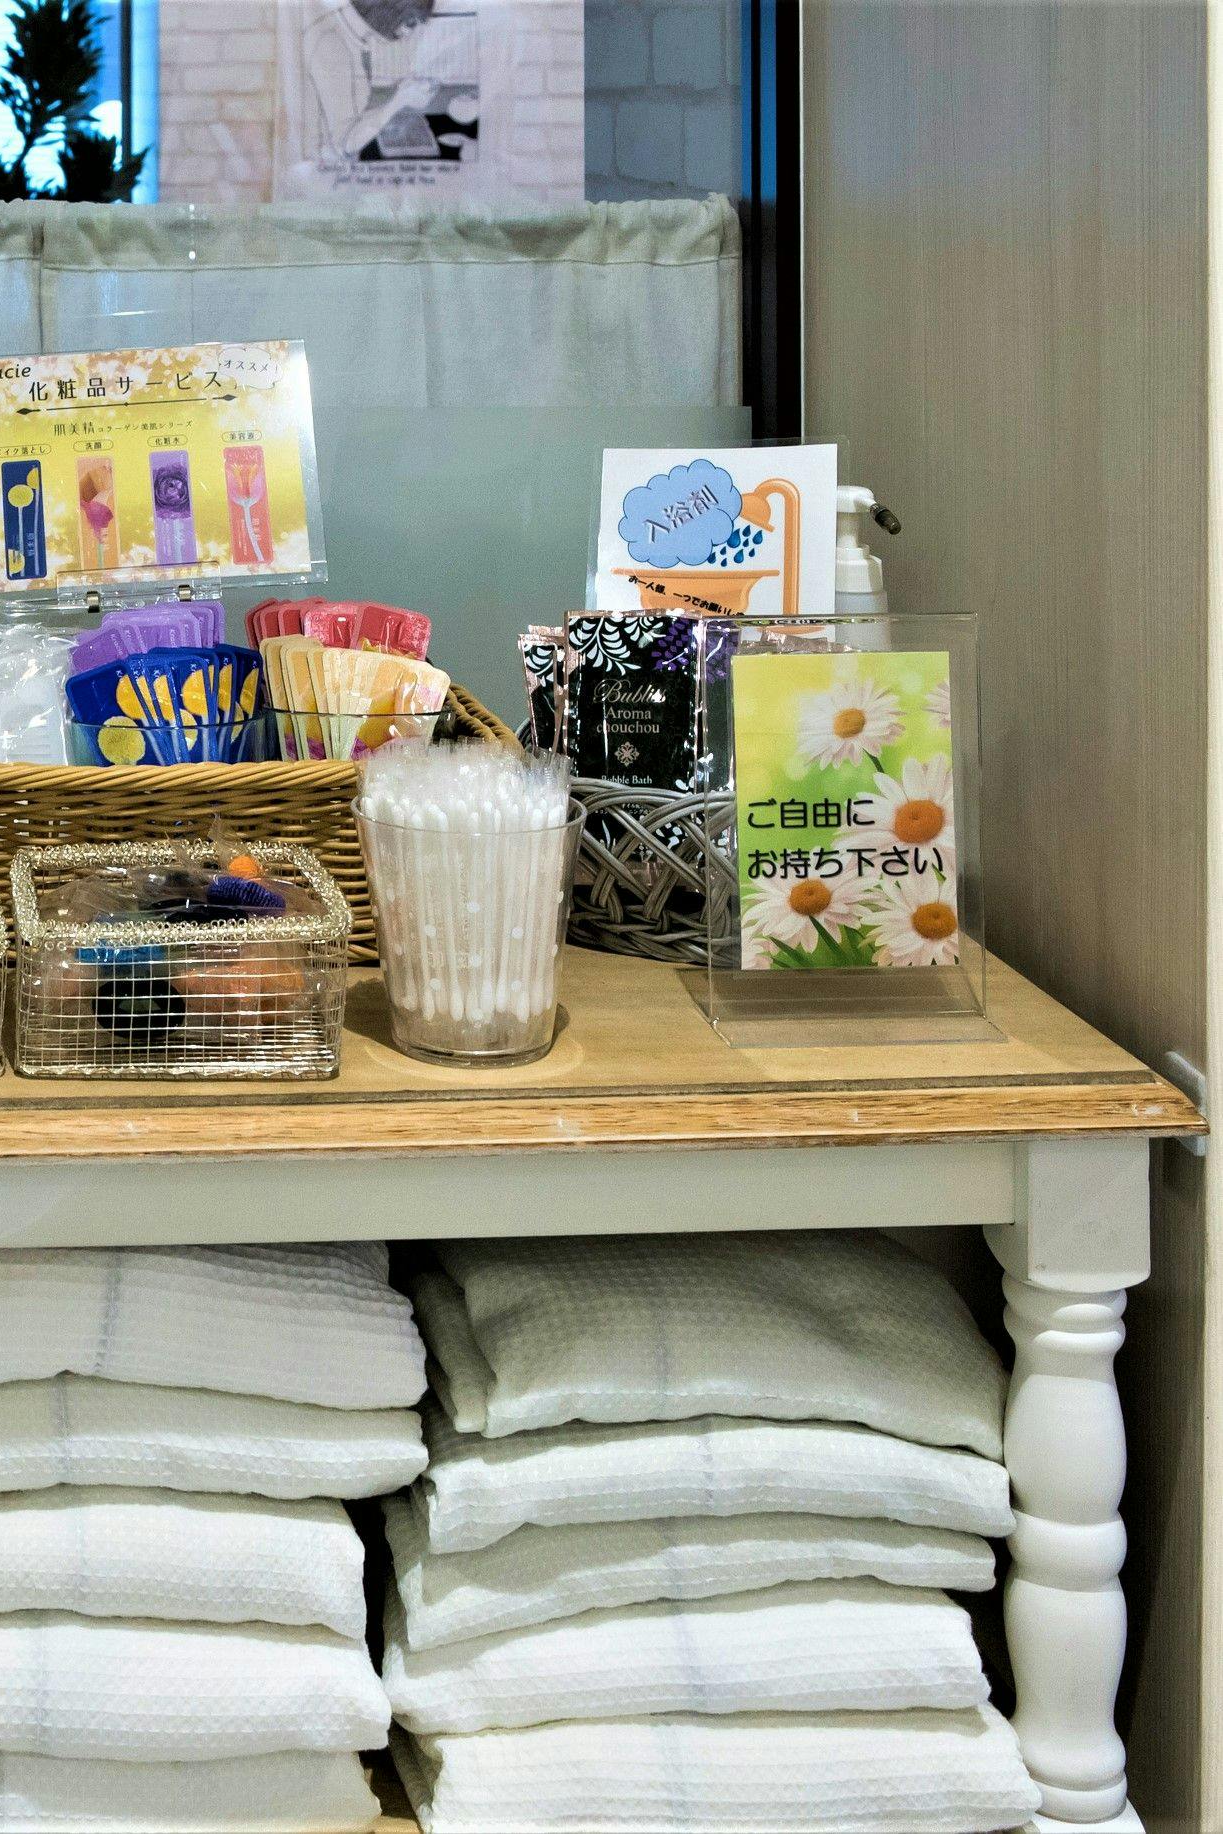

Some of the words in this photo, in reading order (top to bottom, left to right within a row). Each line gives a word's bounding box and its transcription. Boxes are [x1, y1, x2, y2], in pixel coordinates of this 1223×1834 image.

[29, 371, 221, 402] 化粧品サービス
[643, 484, 719, 543] 入浴剤
[593, 679, 667, 703] Bubli
[605, 706, 652, 720] Aroma
[596, 720, 660, 734] chouchou
[631, 774, 653, 785] Bath
[748, 798, 875, 830] ご自由に
[748, 845, 945, 880] お持ち下さい
